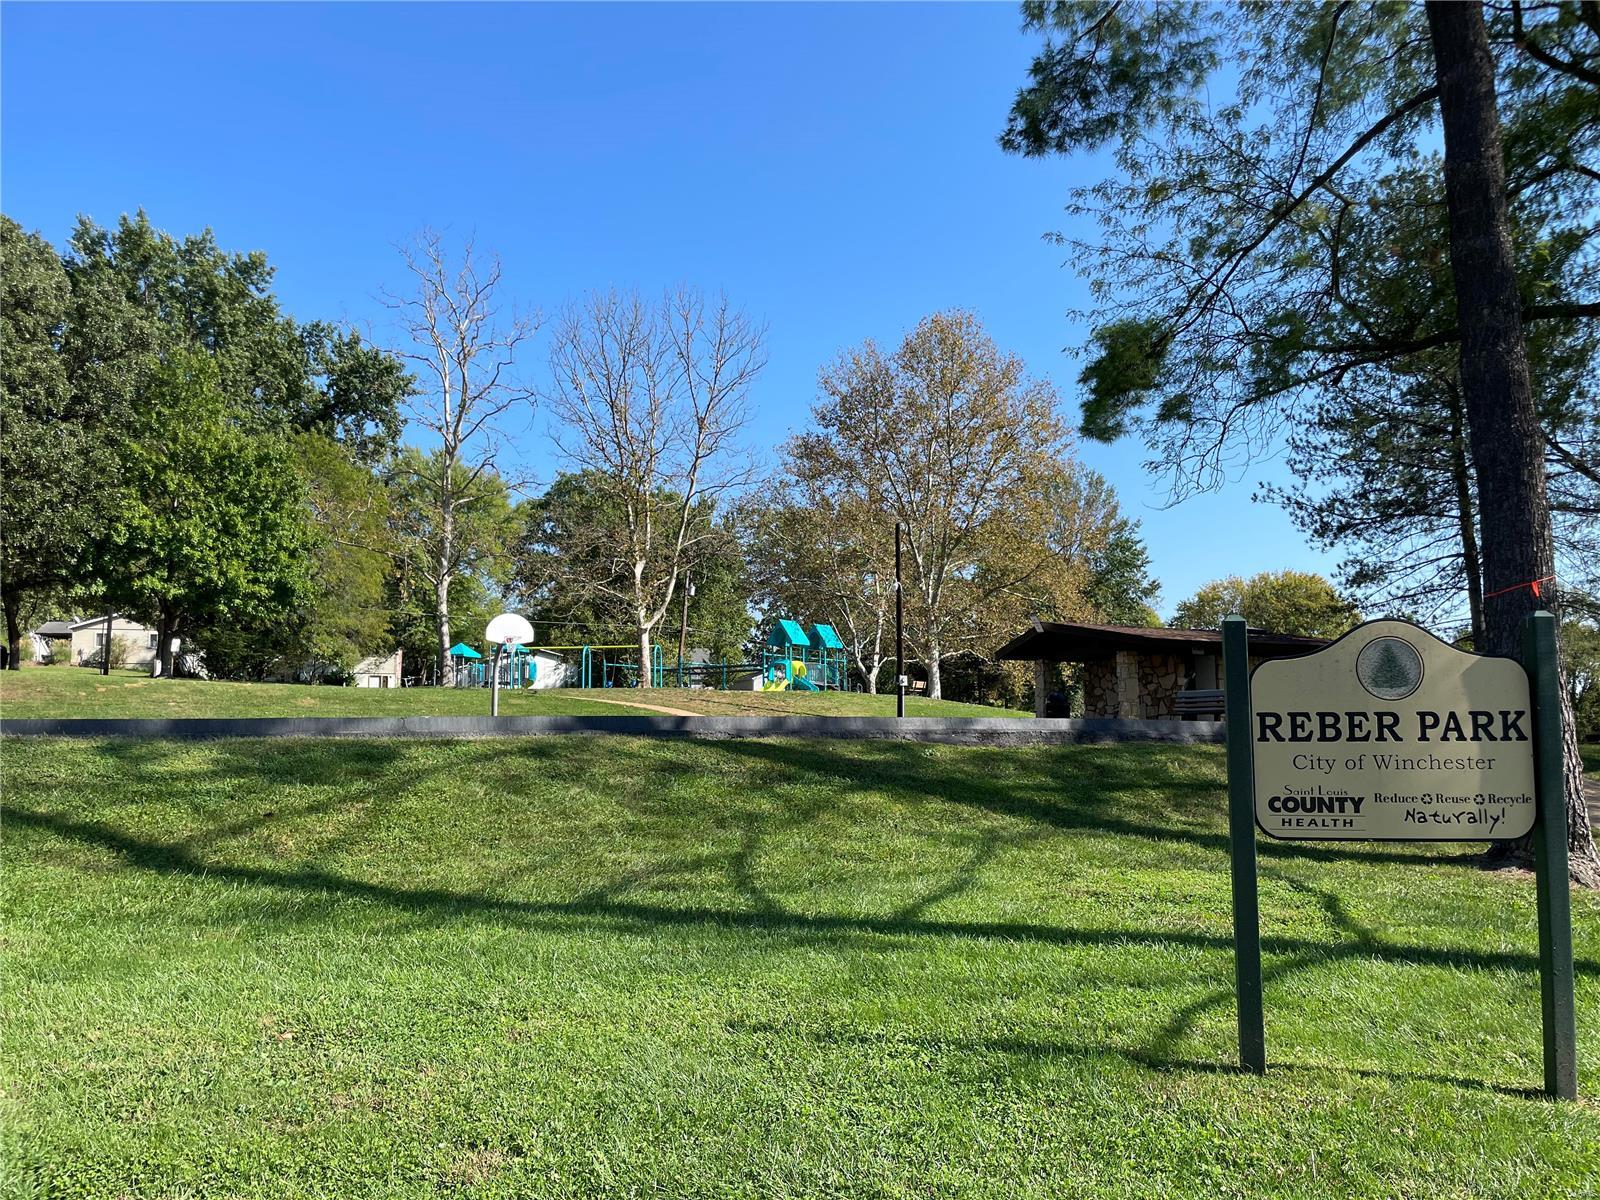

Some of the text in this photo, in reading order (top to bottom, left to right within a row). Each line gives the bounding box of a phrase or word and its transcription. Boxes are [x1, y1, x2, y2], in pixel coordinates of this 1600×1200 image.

[1256, 710, 1528, 742] REBER PARK
[1293, 754, 1496, 774] City of Winchester
[1283, 785, 1348, 796] Saint Louis
[1268, 796, 1365, 813] COUNTY
[1374, 792, 1532, 807] Reduce Reuse Recycle
[1281, 818, 1353, 827] HEALTH
[1404, 807, 1505, 834] Naturally!
